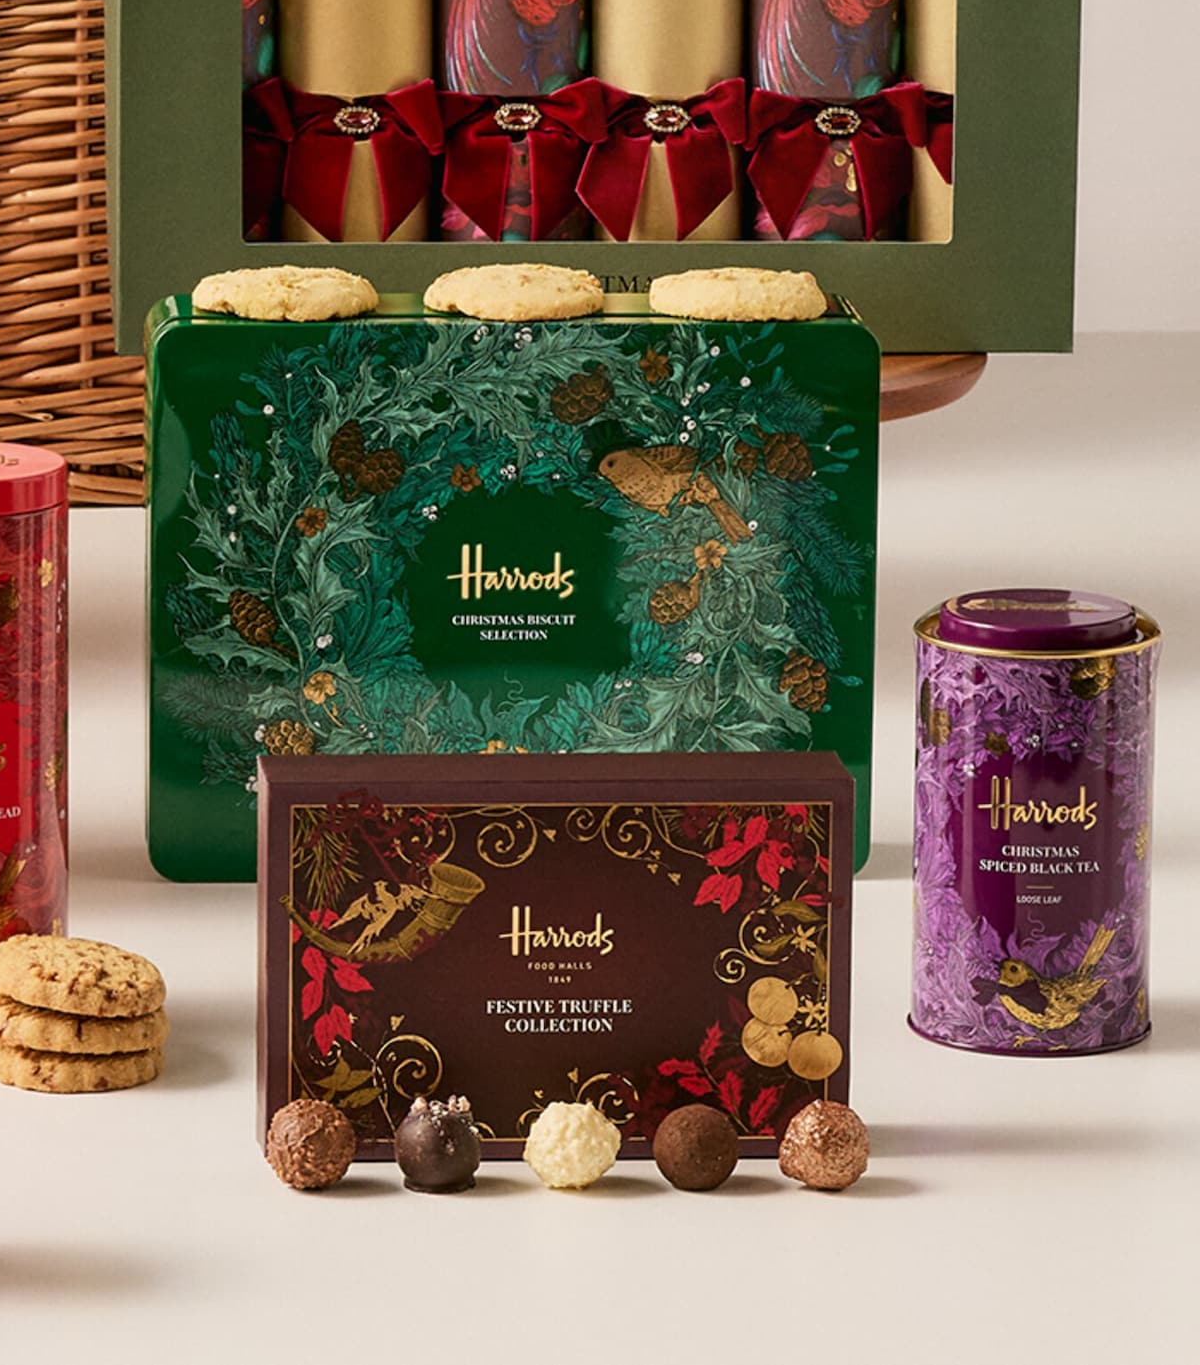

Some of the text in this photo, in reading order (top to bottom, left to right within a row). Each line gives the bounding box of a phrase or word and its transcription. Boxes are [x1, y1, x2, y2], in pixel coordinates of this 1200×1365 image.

[447, 543, 574, 599] Harrods
[452, 615, 576, 625] CHRISTMAS BISCUIT
[480, 630, 548, 640] SELECTION
[978, 775, 1097, 830] Harrods
[1002, 845, 1079, 858] CHRISTMAS
[979, 859, 1099, 874] SPICED BLACK TEA
[1016, 895, 1041, 904] LOOSE
[499, 906, 614, 956] Harrods
[528, 962, 592, 970] FOOD HALLS
[486, 1000, 632, 1014] FESTIVE TRUFFLE
[505, 1018, 613, 1033] COLLECTION
